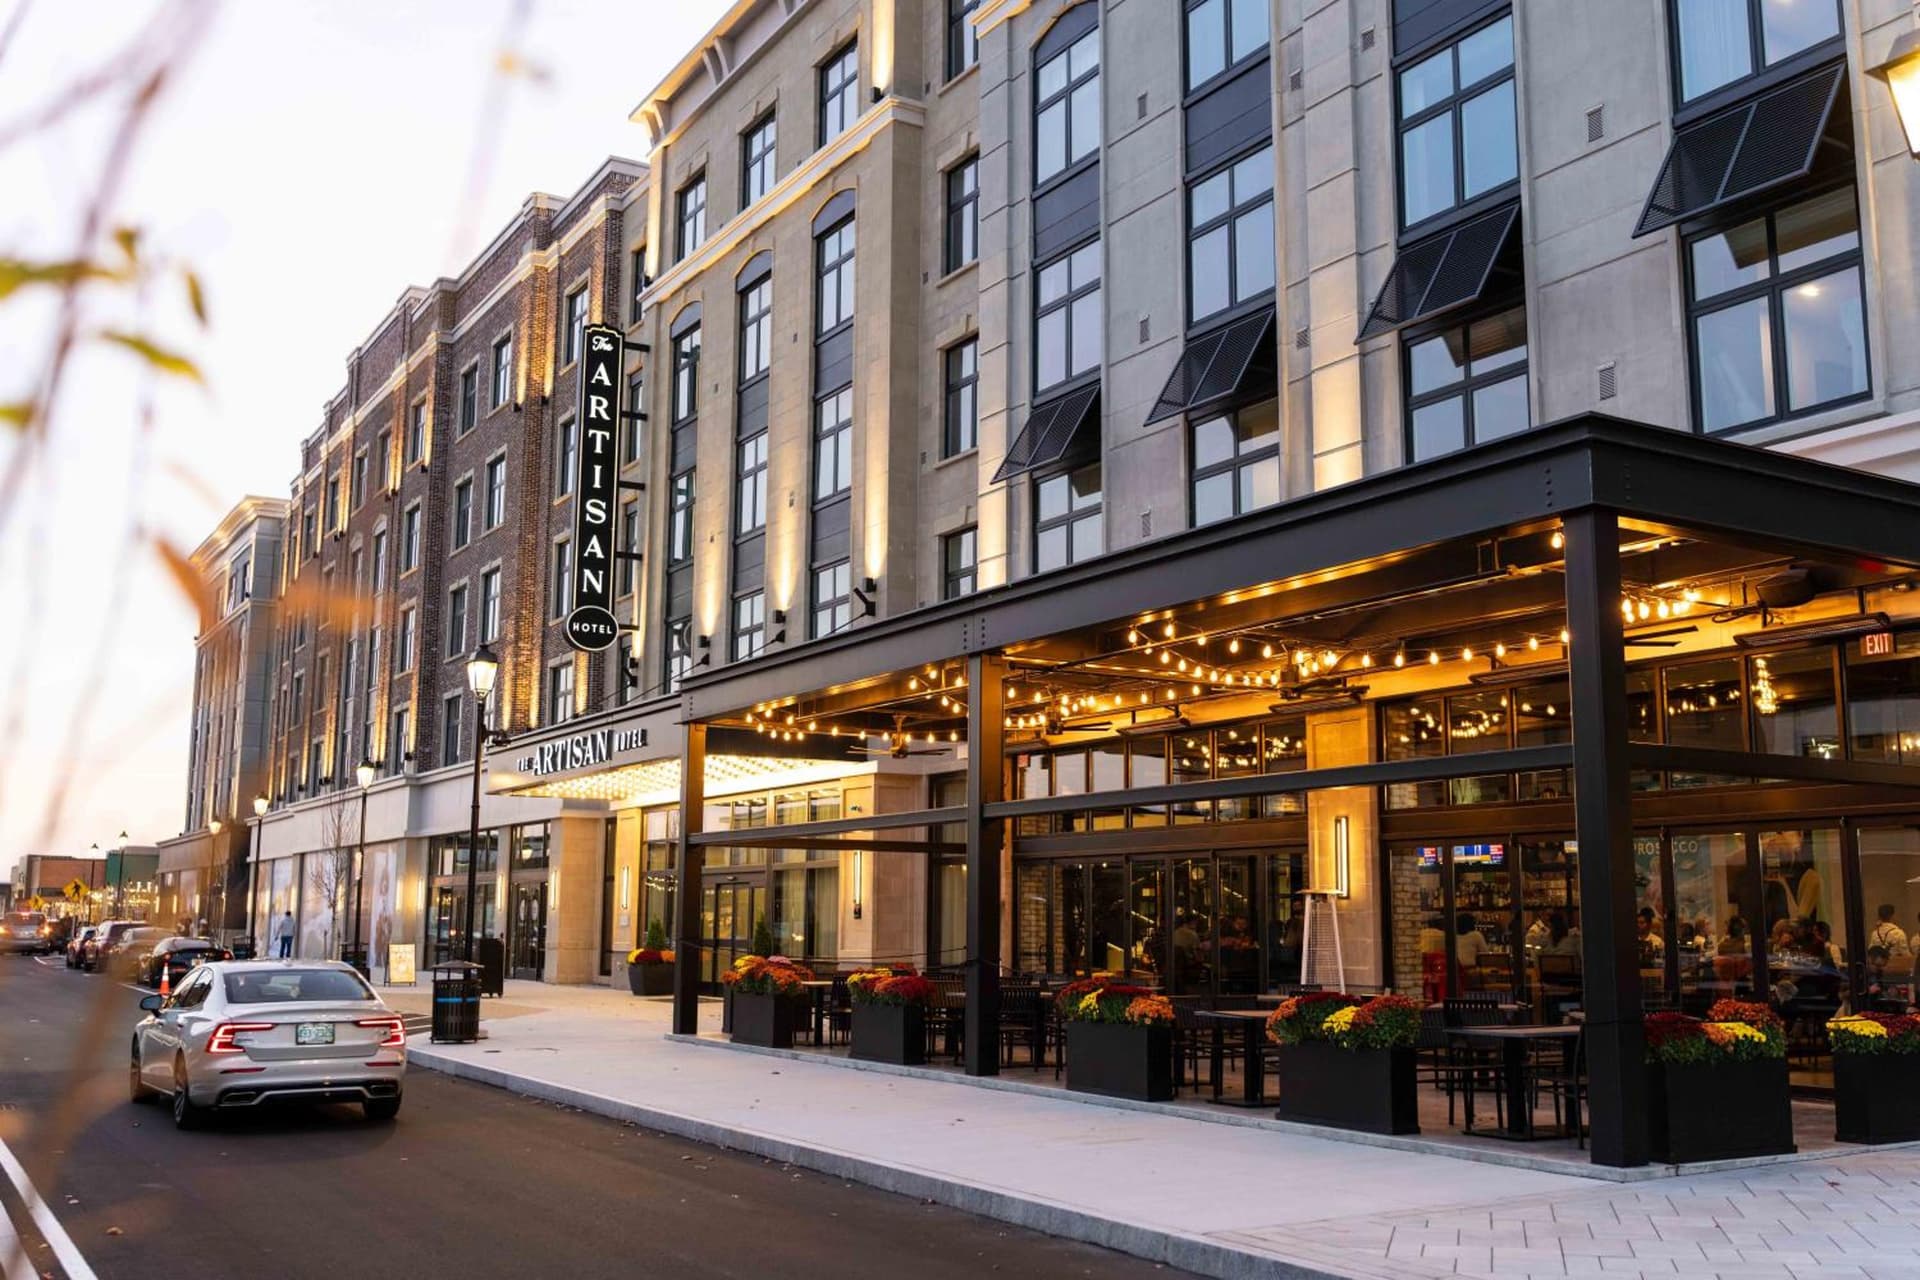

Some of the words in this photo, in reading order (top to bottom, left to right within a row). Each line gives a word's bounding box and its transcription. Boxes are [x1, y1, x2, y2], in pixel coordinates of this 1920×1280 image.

[592, 335, 614, 351] The
[582, 361, 612, 594] ARTISAN
[572, 621, 613, 634] HOTEL
[1865, 633, 1889, 655] EXIT
[532, 729, 609, 776] ARTISAN
[614, 728, 643, 753] HOTEL
